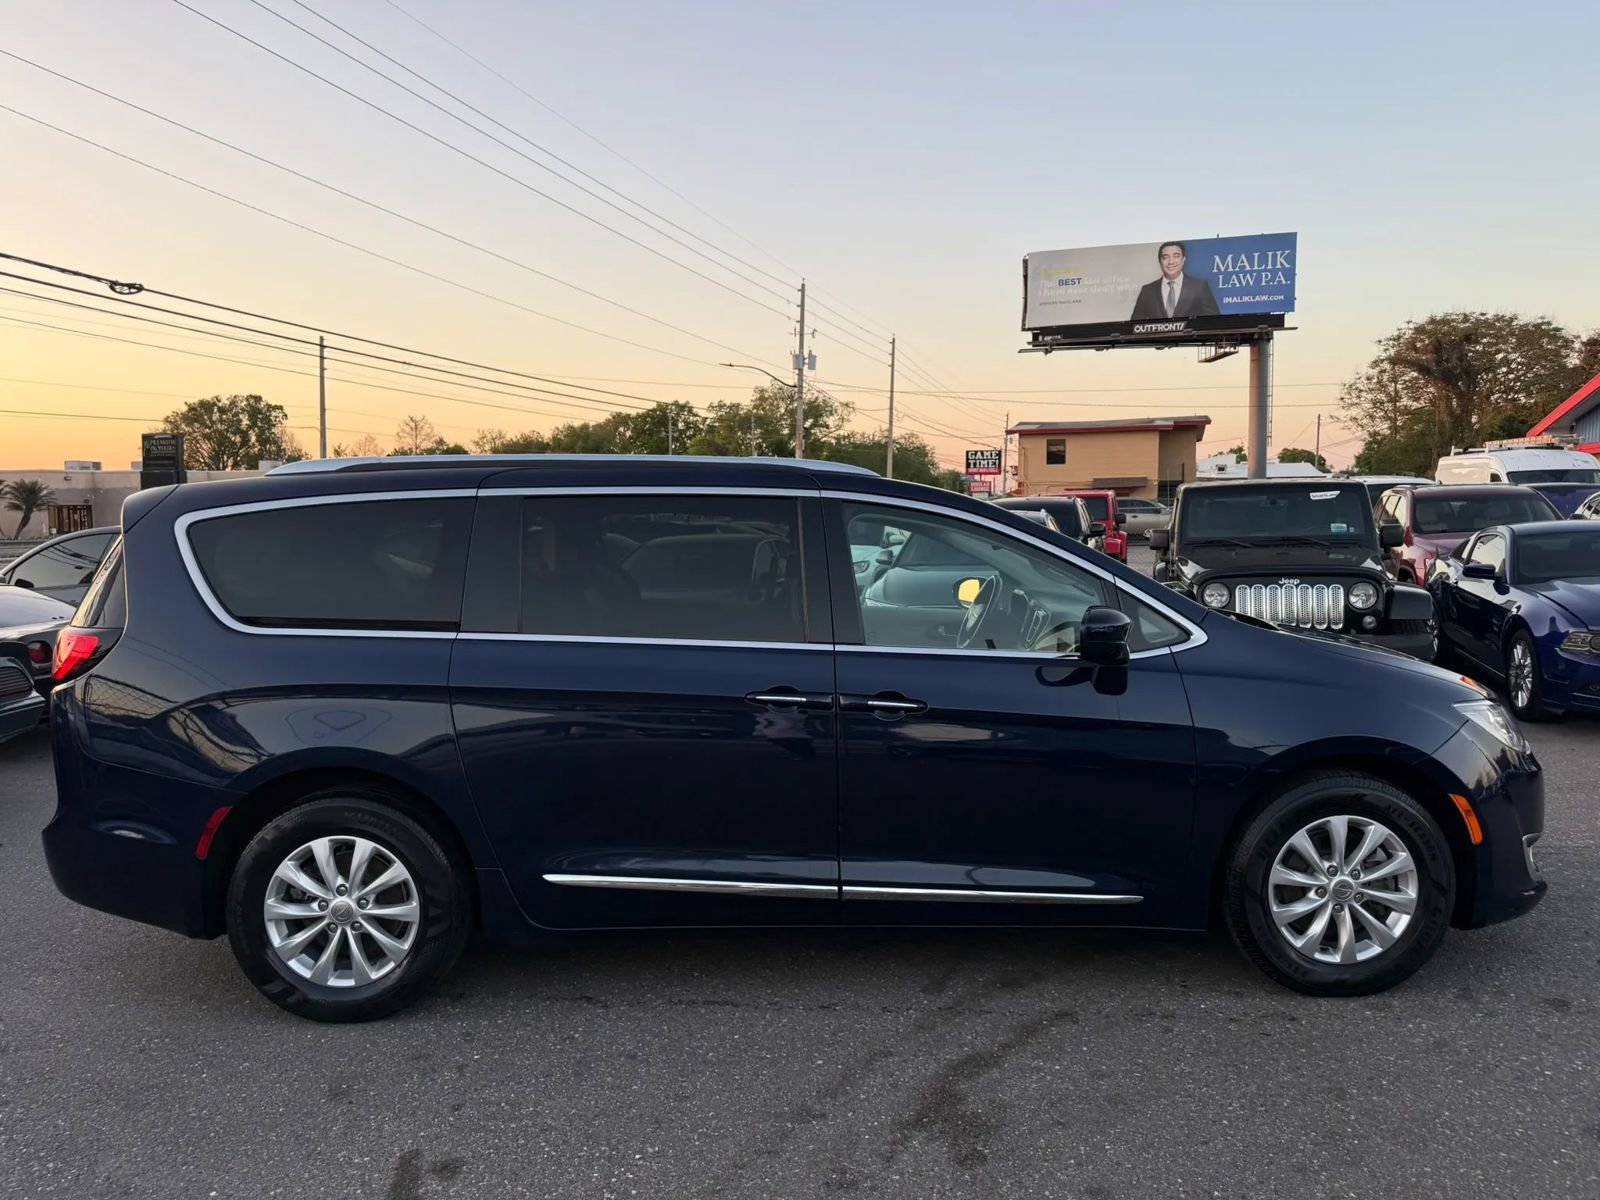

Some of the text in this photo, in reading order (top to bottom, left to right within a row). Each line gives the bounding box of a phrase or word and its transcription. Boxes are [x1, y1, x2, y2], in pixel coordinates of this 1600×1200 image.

[1212, 250, 1291, 273] MALIK
[1058, 277, 1082, 287] BEST
[1218, 271, 1291, 289] LAW P.A.
[968, 450, 999, 460] GAME
[968, 459, 999, 468] TIME!
[1278, 577, 1300, 585] Jeep
